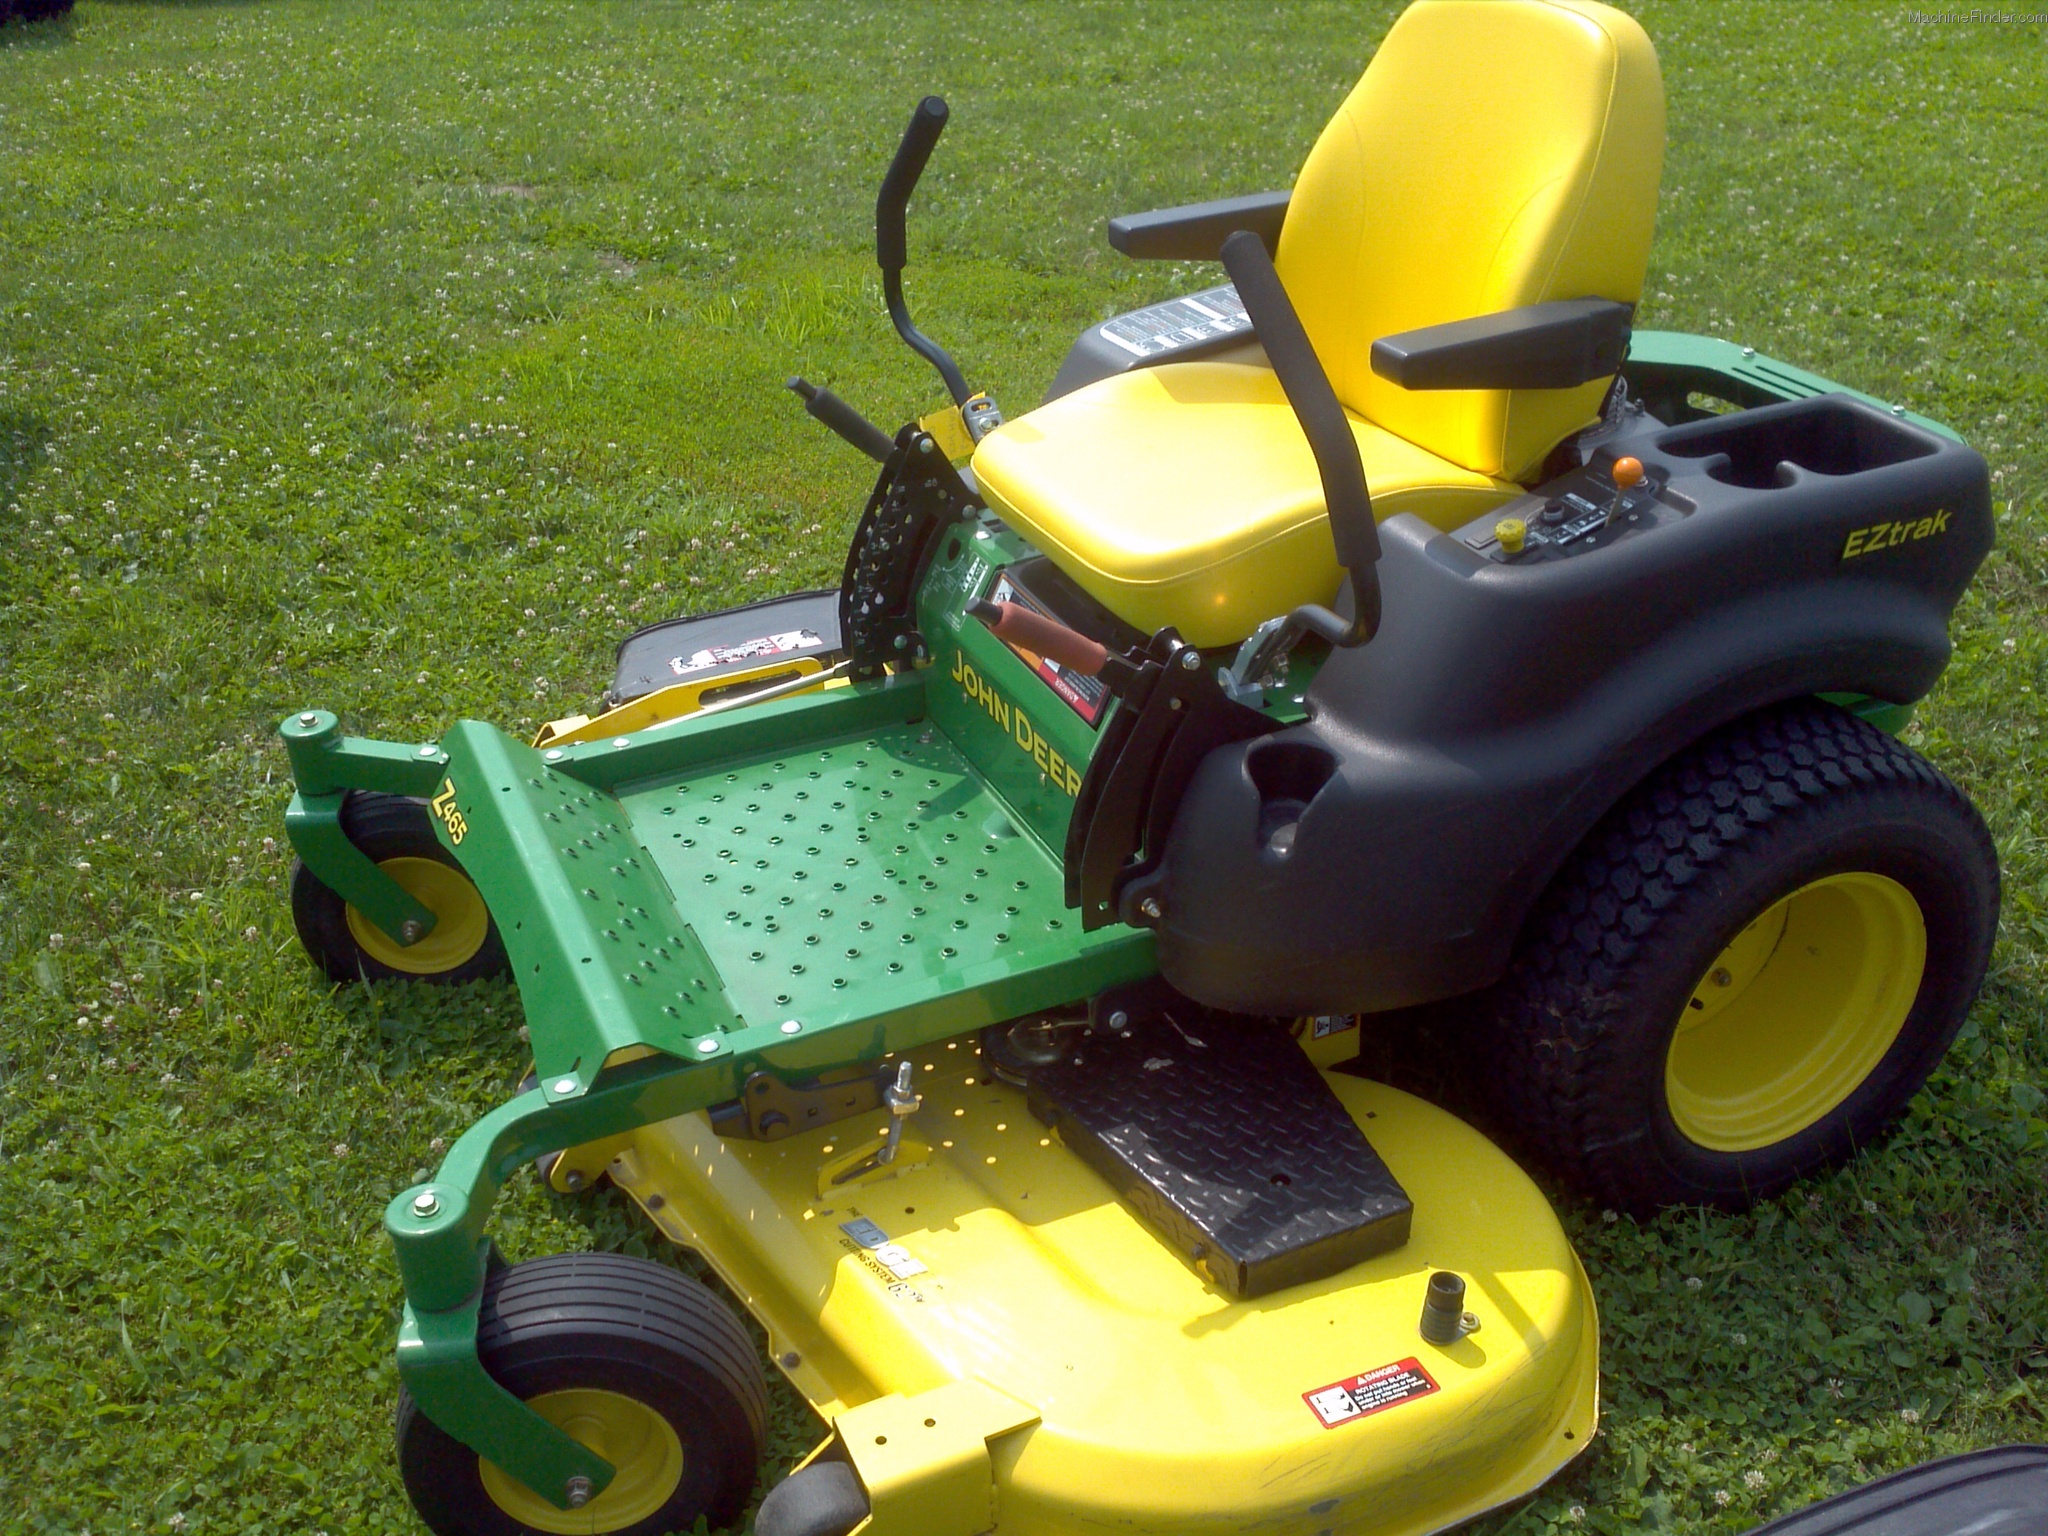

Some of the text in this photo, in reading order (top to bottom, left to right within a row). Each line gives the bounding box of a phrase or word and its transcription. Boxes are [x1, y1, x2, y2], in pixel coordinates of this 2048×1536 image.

[1842, 508, 1953, 560] EZtrak
[952, 649, 1084, 799] JOHN DEER
[431, 776, 468, 846] Z465
[1364, 1364, 1401, 1382] DANGER
